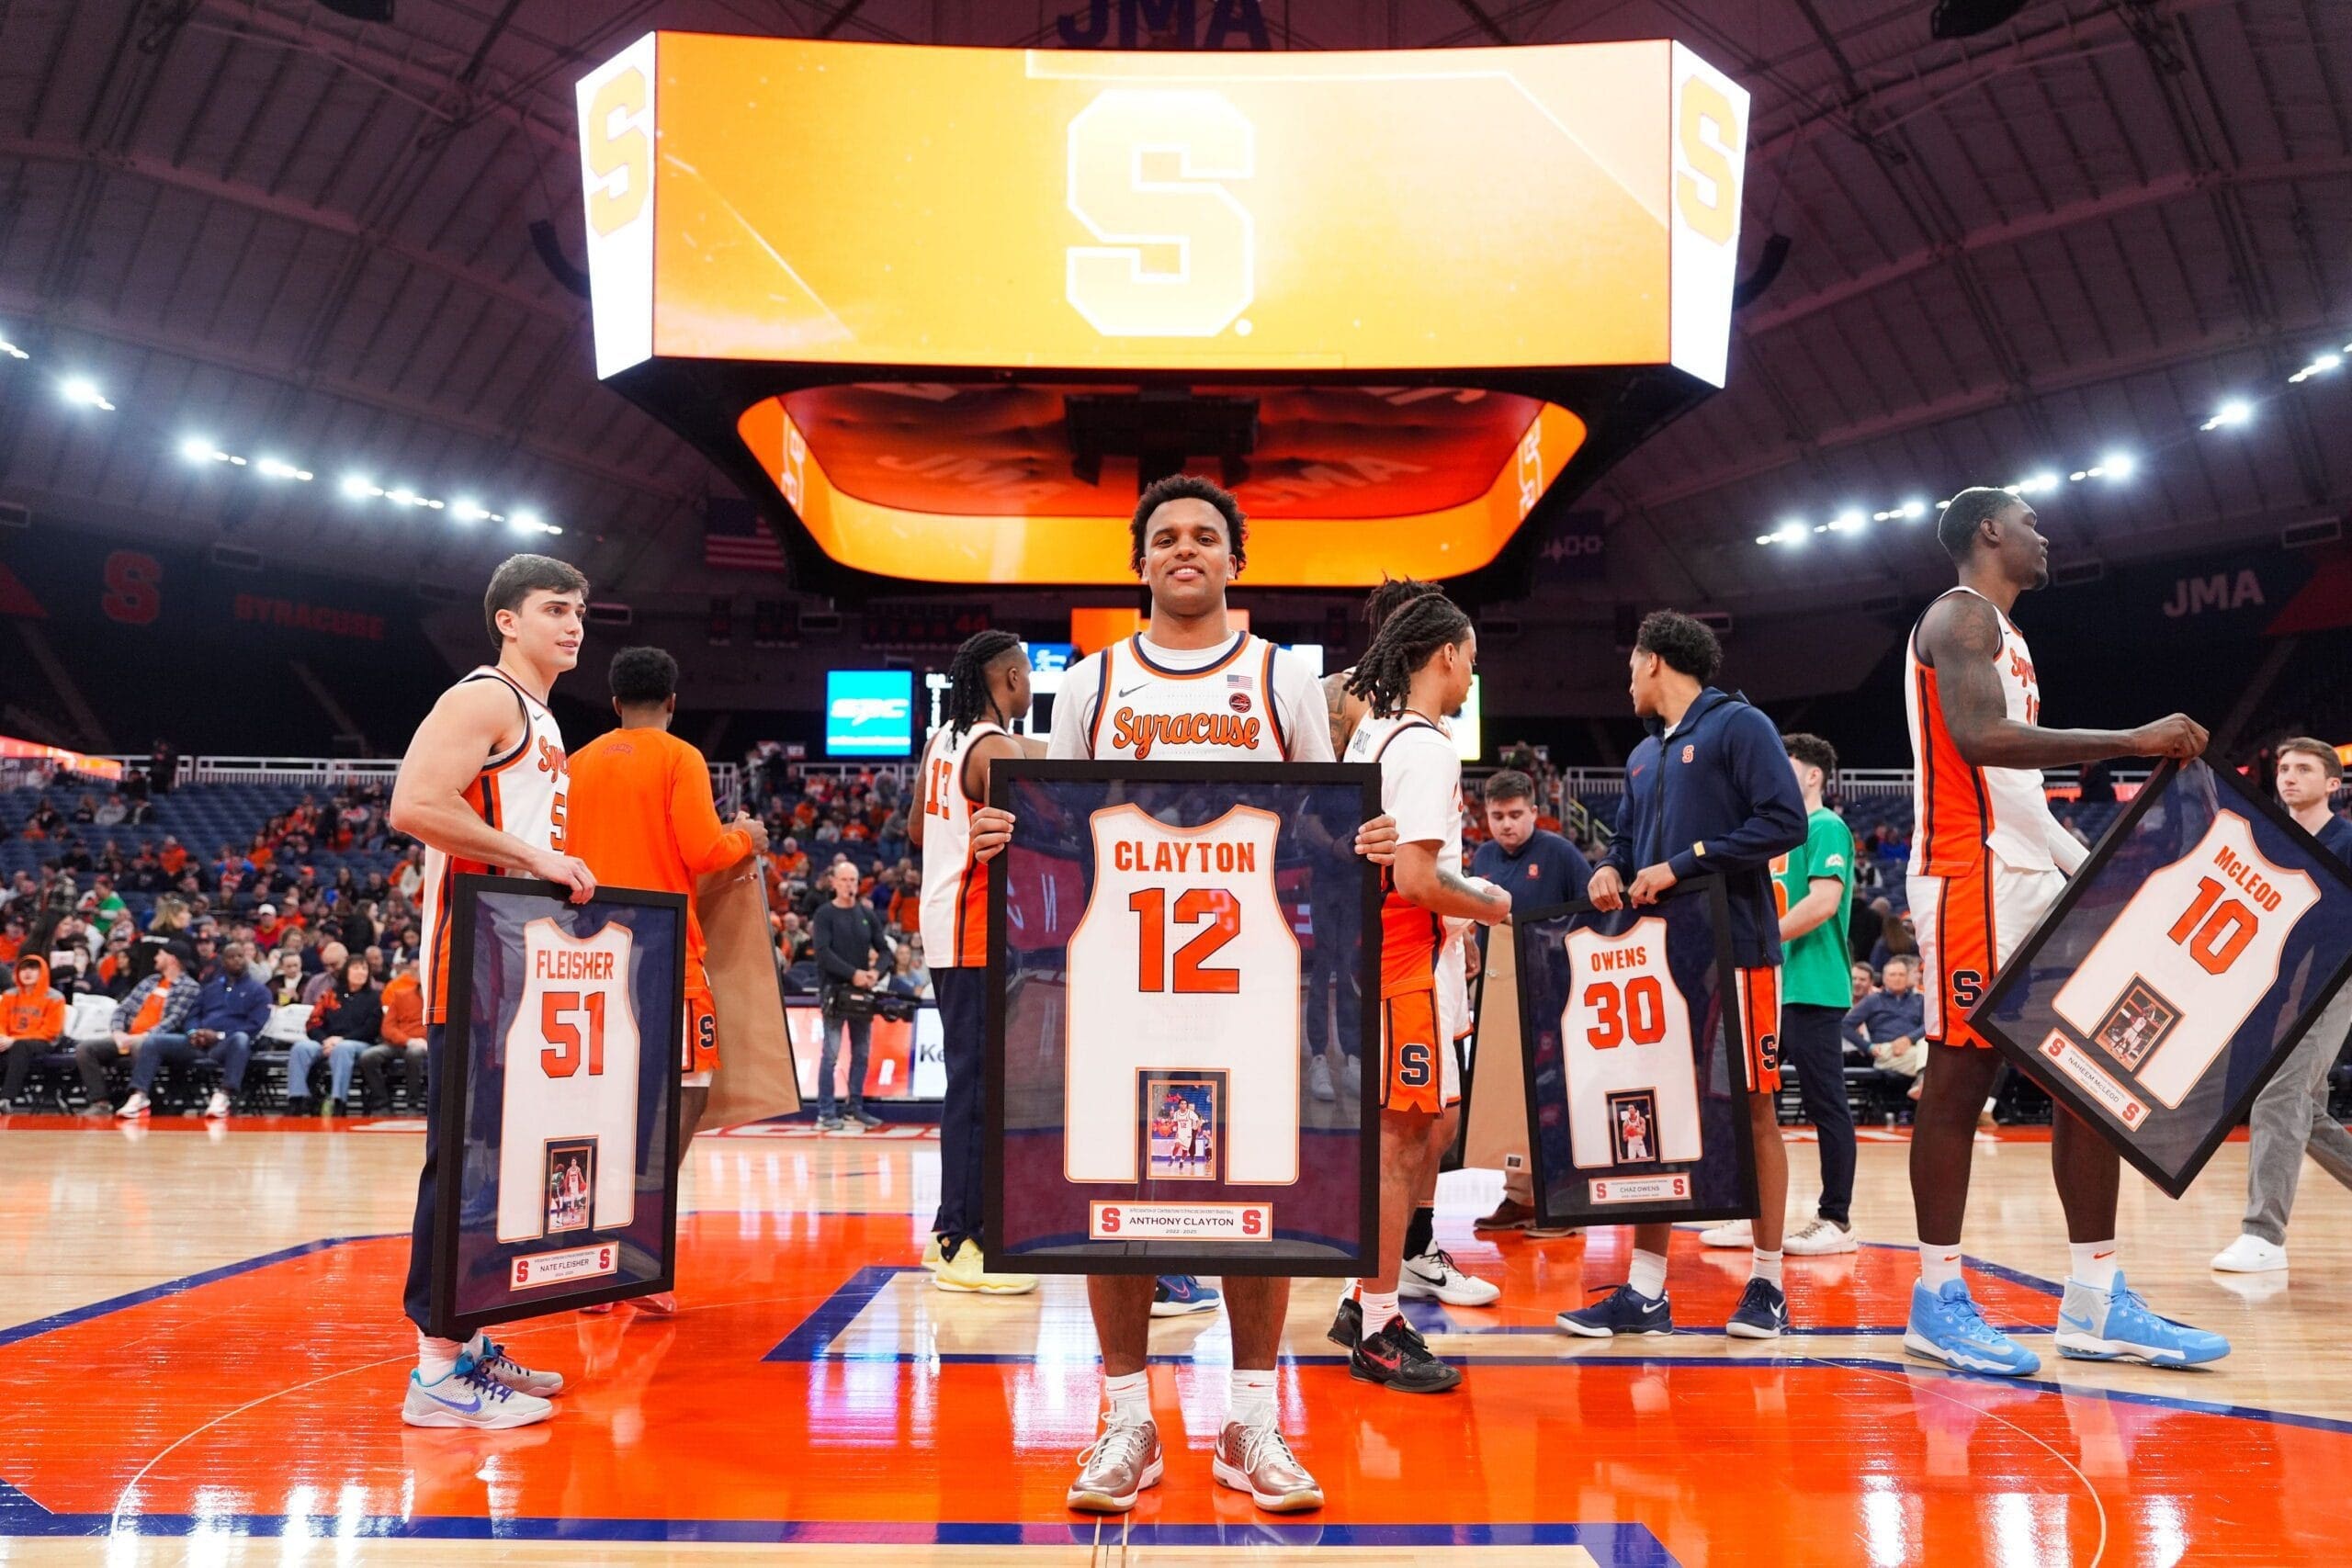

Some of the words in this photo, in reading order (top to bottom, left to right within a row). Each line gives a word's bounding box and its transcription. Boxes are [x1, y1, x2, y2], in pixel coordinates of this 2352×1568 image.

[1057, 0, 1272, 49] JMA
[587, 66, 649, 237] S
[1678, 74, 1740, 246] S
[1067, 88, 1255, 337] S
[100, 549, 161, 625] S
[2163, 569, 2266, 617] JMA
[234, 592, 386, 641] SYRACUSE
[1113, 706, 1261, 760] Syracuse
[1681, 744, 1695, 763] S
[1114, 840, 1256, 873] CLAYTON
[2213, 845, 2281, 912] McLEOD
[1129, 887, 1240, 994] 12
[2167, 876, 2258, 975] 10
[537, 950, 614, 979] FLEISHER
[1590, 946, 1646, 972] OWENS
[1951, 969, 1983, 1009] S
[1584, 976, 1666, 1049] 30
[541, 991, 605, 1078] 51
[698, 1014, 717, 1049] S
[2048, 1038, 2065, 1057] S
[1399, 1043, 1430, 1087] S
[1759, 1033, 1777, 1071] S
[2067, 1056, 2096, 1082] NAHEEM
[2122, 1102, 2140, 1122] S
[1596, 1183, 1607, 1199] S
[1673, 1179, 1684, 1195] S
[1102, 1207, 1120, 1232] S
[1129, 1217, 1181, 1225] ANTHONY
[1183, 1217, 1234, 1226] CLAYTON
[1242, 1210, 1261, 1235] S
[516, 1260, 528, 1282] S
[539, 1263, 557, 1272] NATE
[559, 1258, 590, 1270] FLEISHER
[599, 1248, 610, 1269] S
